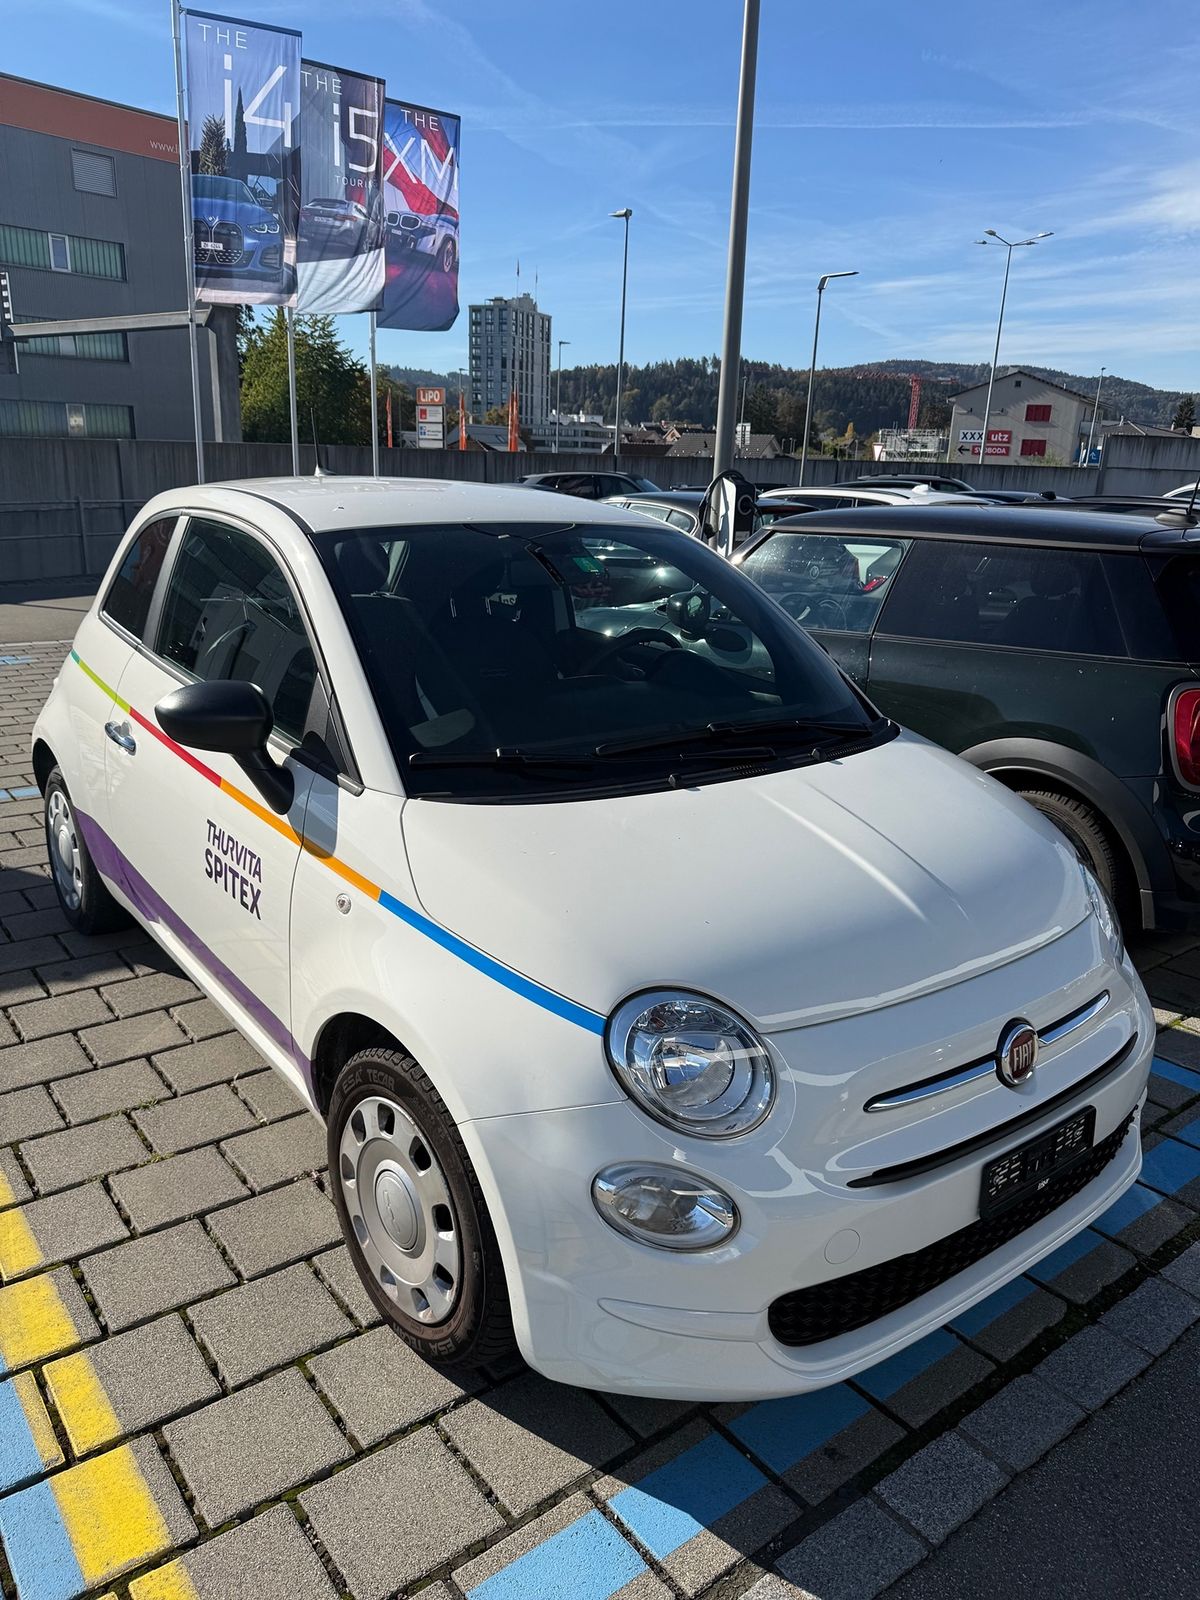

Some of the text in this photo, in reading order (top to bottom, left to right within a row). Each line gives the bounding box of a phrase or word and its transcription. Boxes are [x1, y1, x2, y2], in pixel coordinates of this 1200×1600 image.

[198, 23, 248, 49] THE
[223, 53, 293, 148] i4
[300, 70, 342, 95] THE
[332, 102, 379, 173] i5
[400, 108, 440, 132] THE
[334, 174, 377, 189] TOURI
[384, 132, 459, 191] XM
[206, 818, 262, 883] THURVITA
[205, 848, 262, 920] SPITEX
[1013, 1039, 1032, 1072] FIAT
